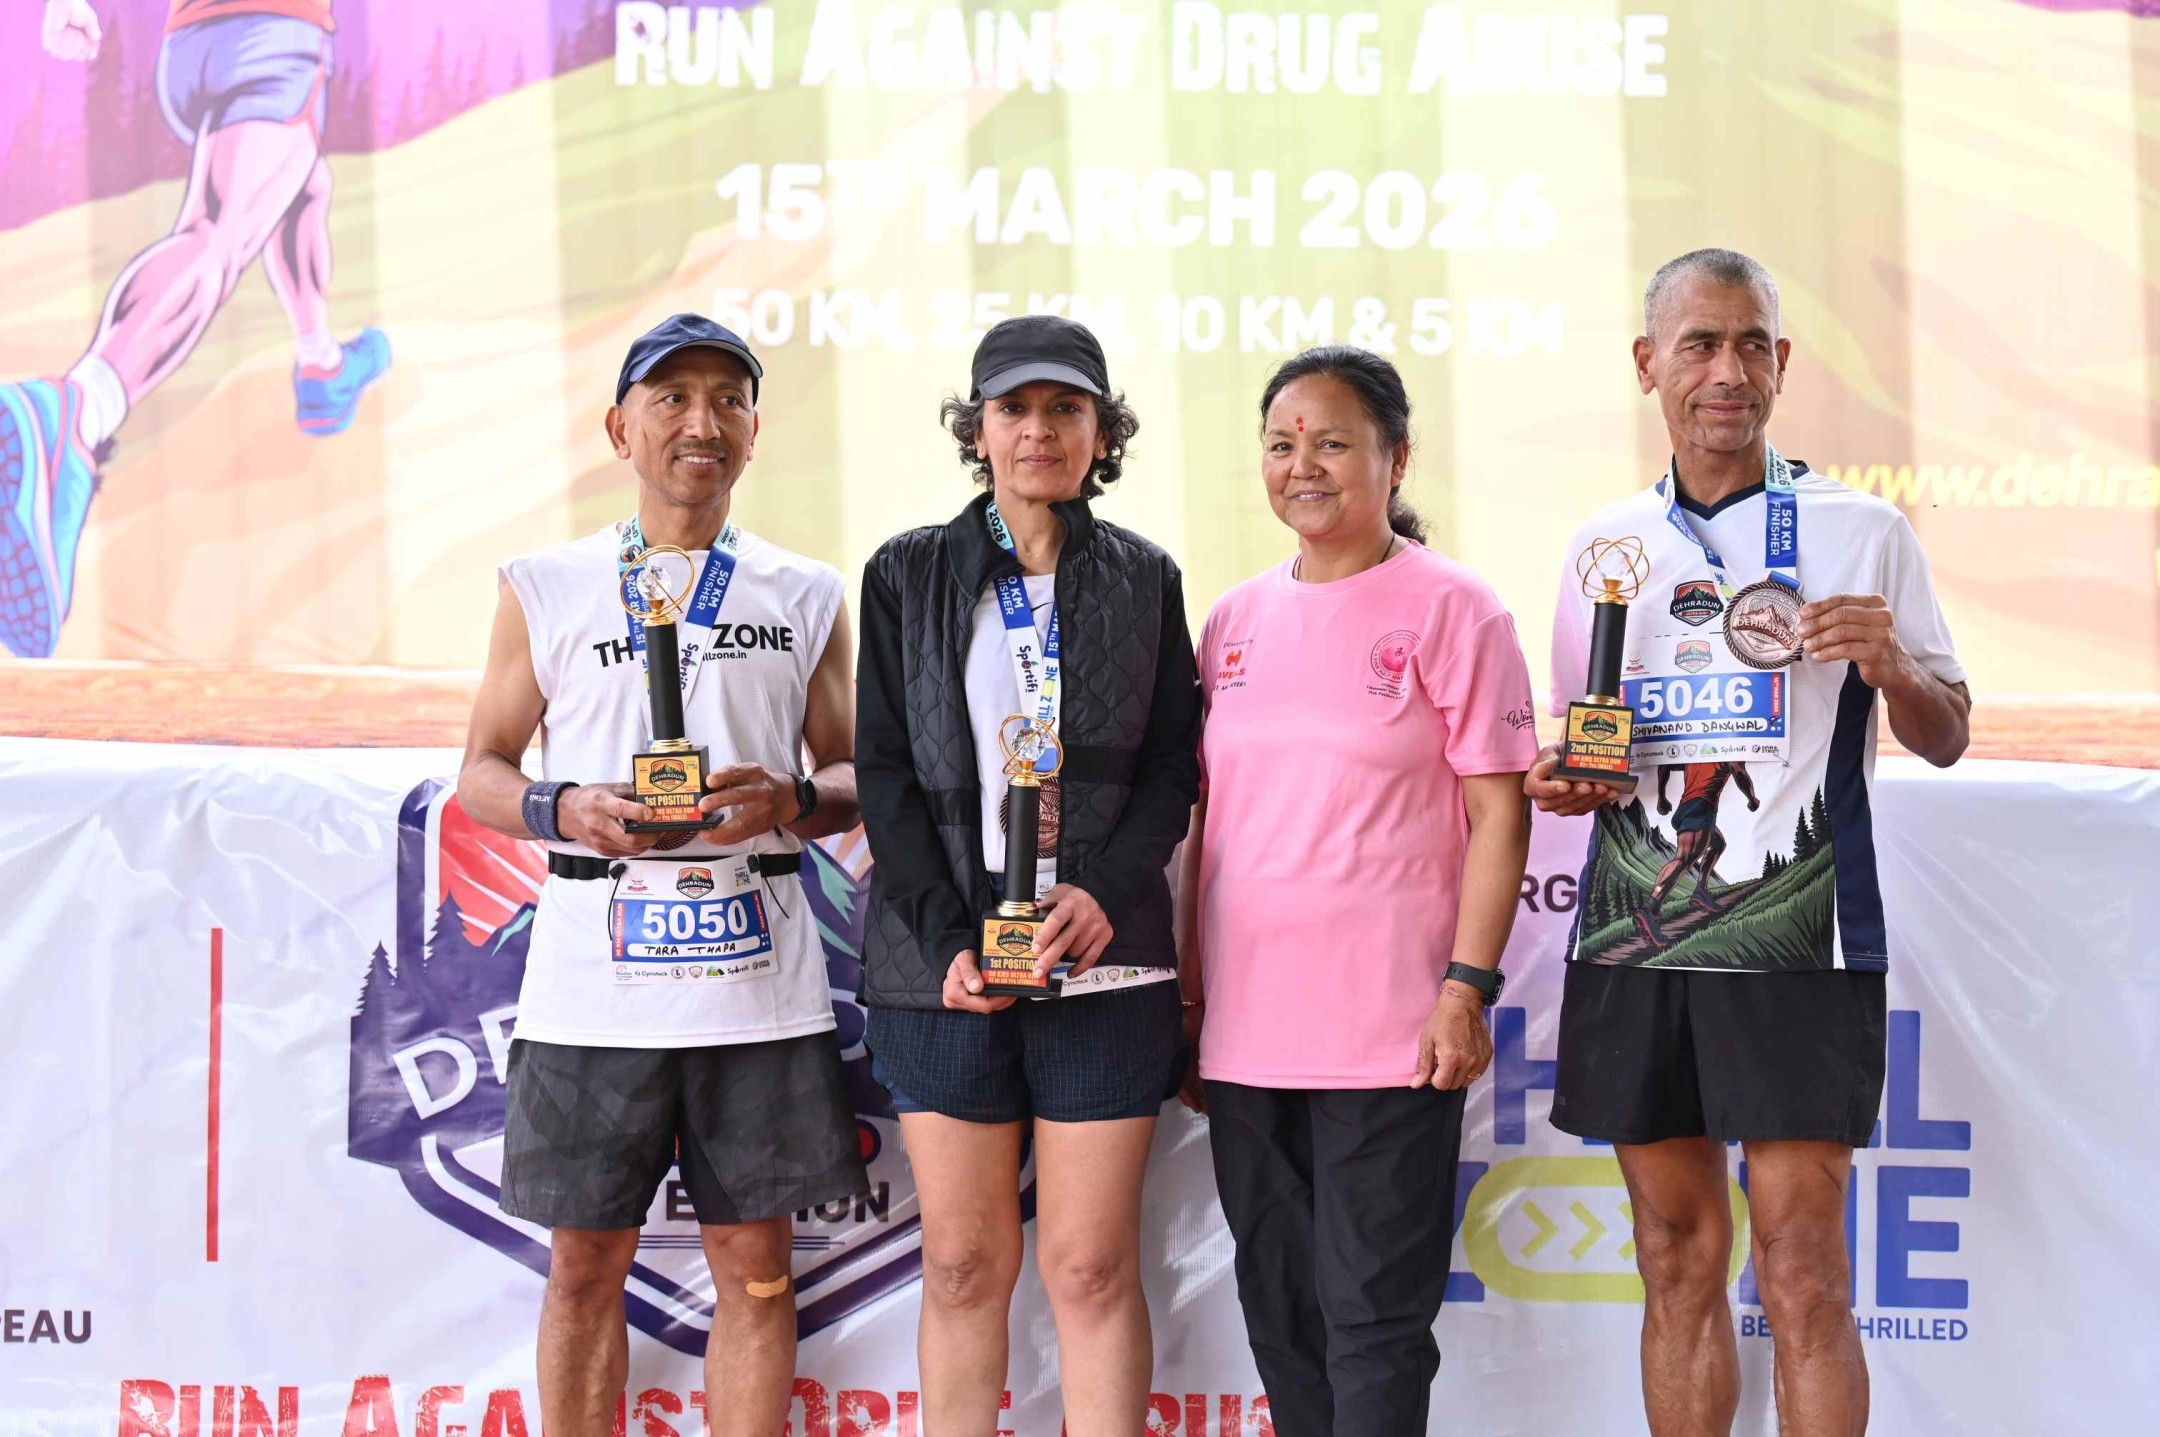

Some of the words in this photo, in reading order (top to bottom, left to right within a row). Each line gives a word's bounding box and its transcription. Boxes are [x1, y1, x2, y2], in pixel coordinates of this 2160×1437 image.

[614, 2, 774, 90] RUN
[800, 0, 1142, 93] AGAINST
[1170, 4, 1382, 96] DRUG
[1407, 3, 1668, 98] ABUSE
[921, 167, 1276, 249] MARCH
[1298, 169, 1559, 252] 2026
[1146, 296, 1225, 353] 10
[1239, 296, 1333, 353] KM
[1409, 297, 1453, 353] 5
[1465, 297, 1564, 357] KM
[988, 508, 1007, 543] 2026
[1770, 501, 1781, 556] FINISHER
[1782, 509, 1792, 528] 50
[1781, 531, 1792, 551] KM
[626, 575, 639, 599] 2026
[696, 560, 721, 611] FINISHER
[717, 569, 729, 586] 50
[707, 586, 723, 609] KM
[1010, 587, 1025, 609] KM
[1672, 600, 1721, 612] DEHRADUN
[711, 624, 793, 652] ZONE
[1736, 618, 1794, 646] DEHRADUN
[1676, 654, 1711, 664] DEHRADUN
[1639, 676, 1754, 719] 5046
[1583, 723, 1616, 733] DEHRADUN
[1570, 743, 1587, 754] 2nd
[1588, 744, 1626, 757] POSITION
[651, 773, 685, 782] DEHRADUN
[644, 795, 657, 806] 1st
[658, 794, 694, 806] POSITION
[677, 879, 712, 889] DEHRADUN
[641, 898, 749, 941] 5050
[644, 946, 679, 956] TARA
[687, 942, 737, 955] THAPA
[990, 957, 1002, 969] 1st
[1003, 958, 1036, 970] POSITIO
[0, 1309, 91, 1344] EAU
[1859, 1317, 1968, 1341] HRILLED
[118, 1378, 300, 1437] RUN
